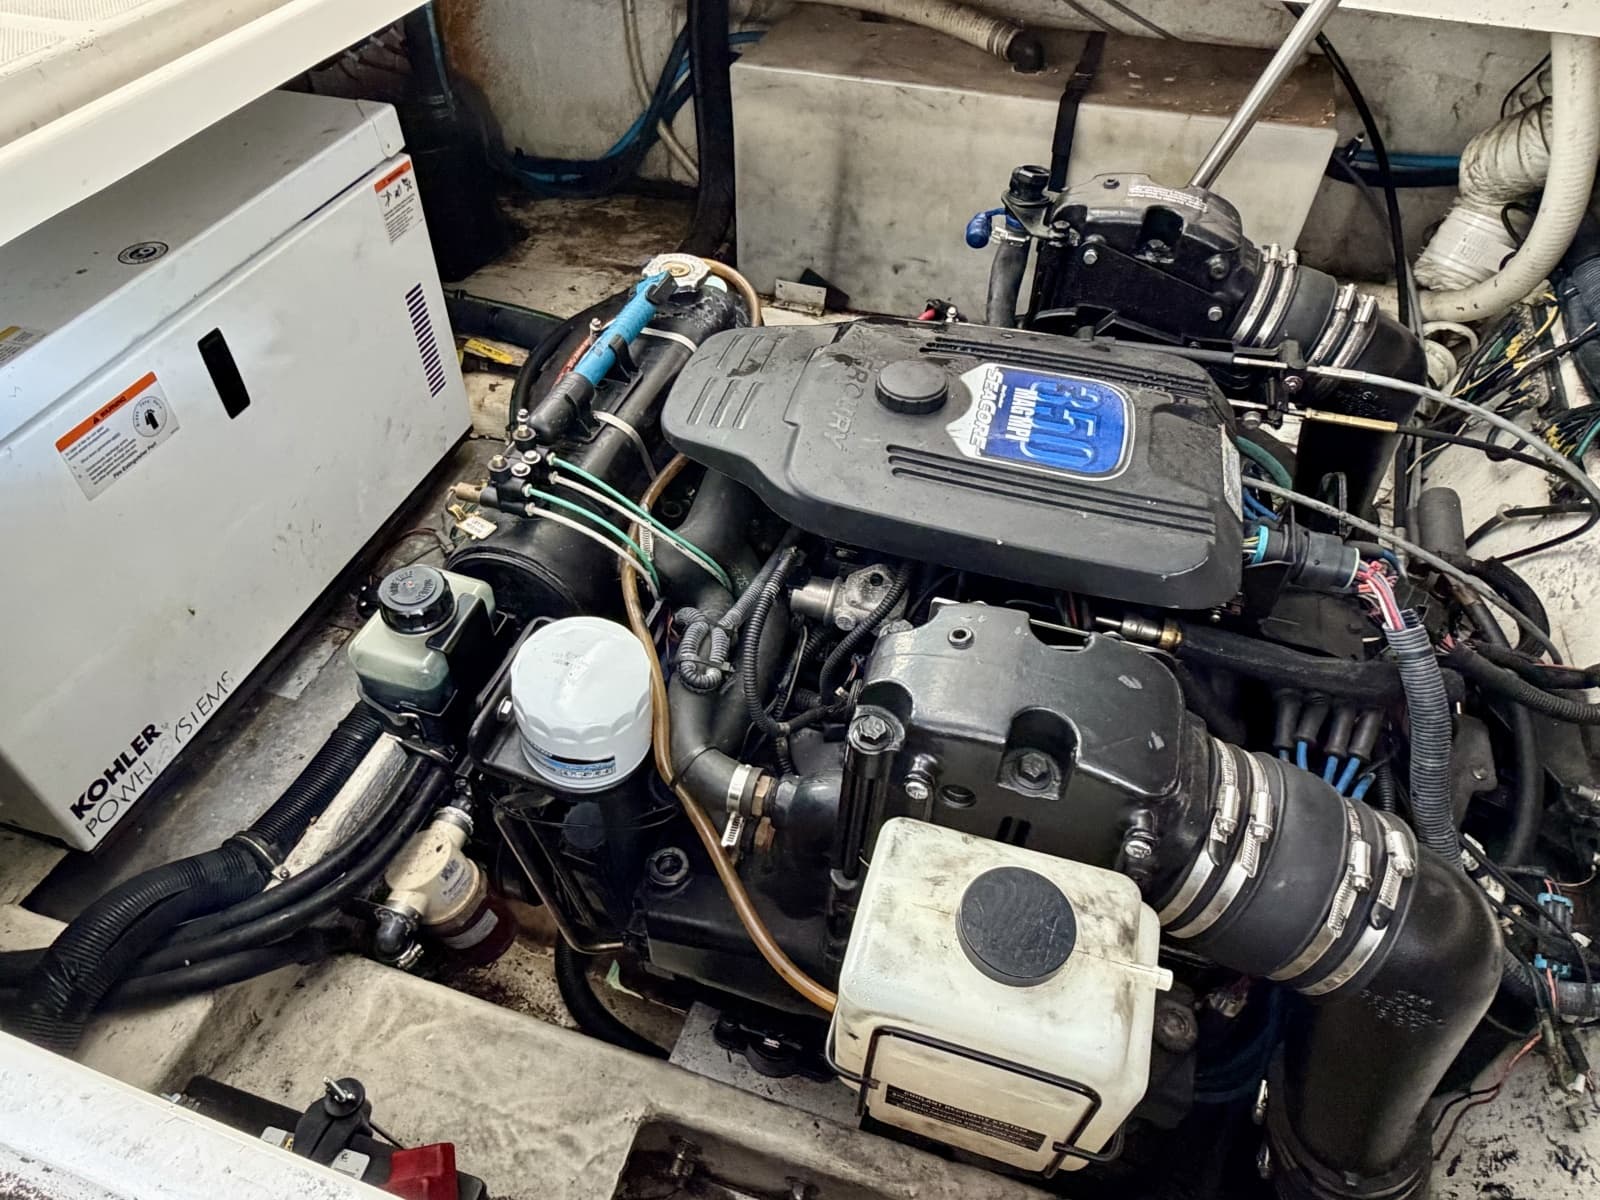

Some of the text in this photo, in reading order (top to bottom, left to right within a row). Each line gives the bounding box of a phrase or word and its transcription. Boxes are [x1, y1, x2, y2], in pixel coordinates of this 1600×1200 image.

[969, 367, 1005, 453] SEACORE
[1004, 387, 1039, 443] MAG MPI
[1019, 381, 1101, 471] 350
[70, 724, 163, 821] KOHLER
